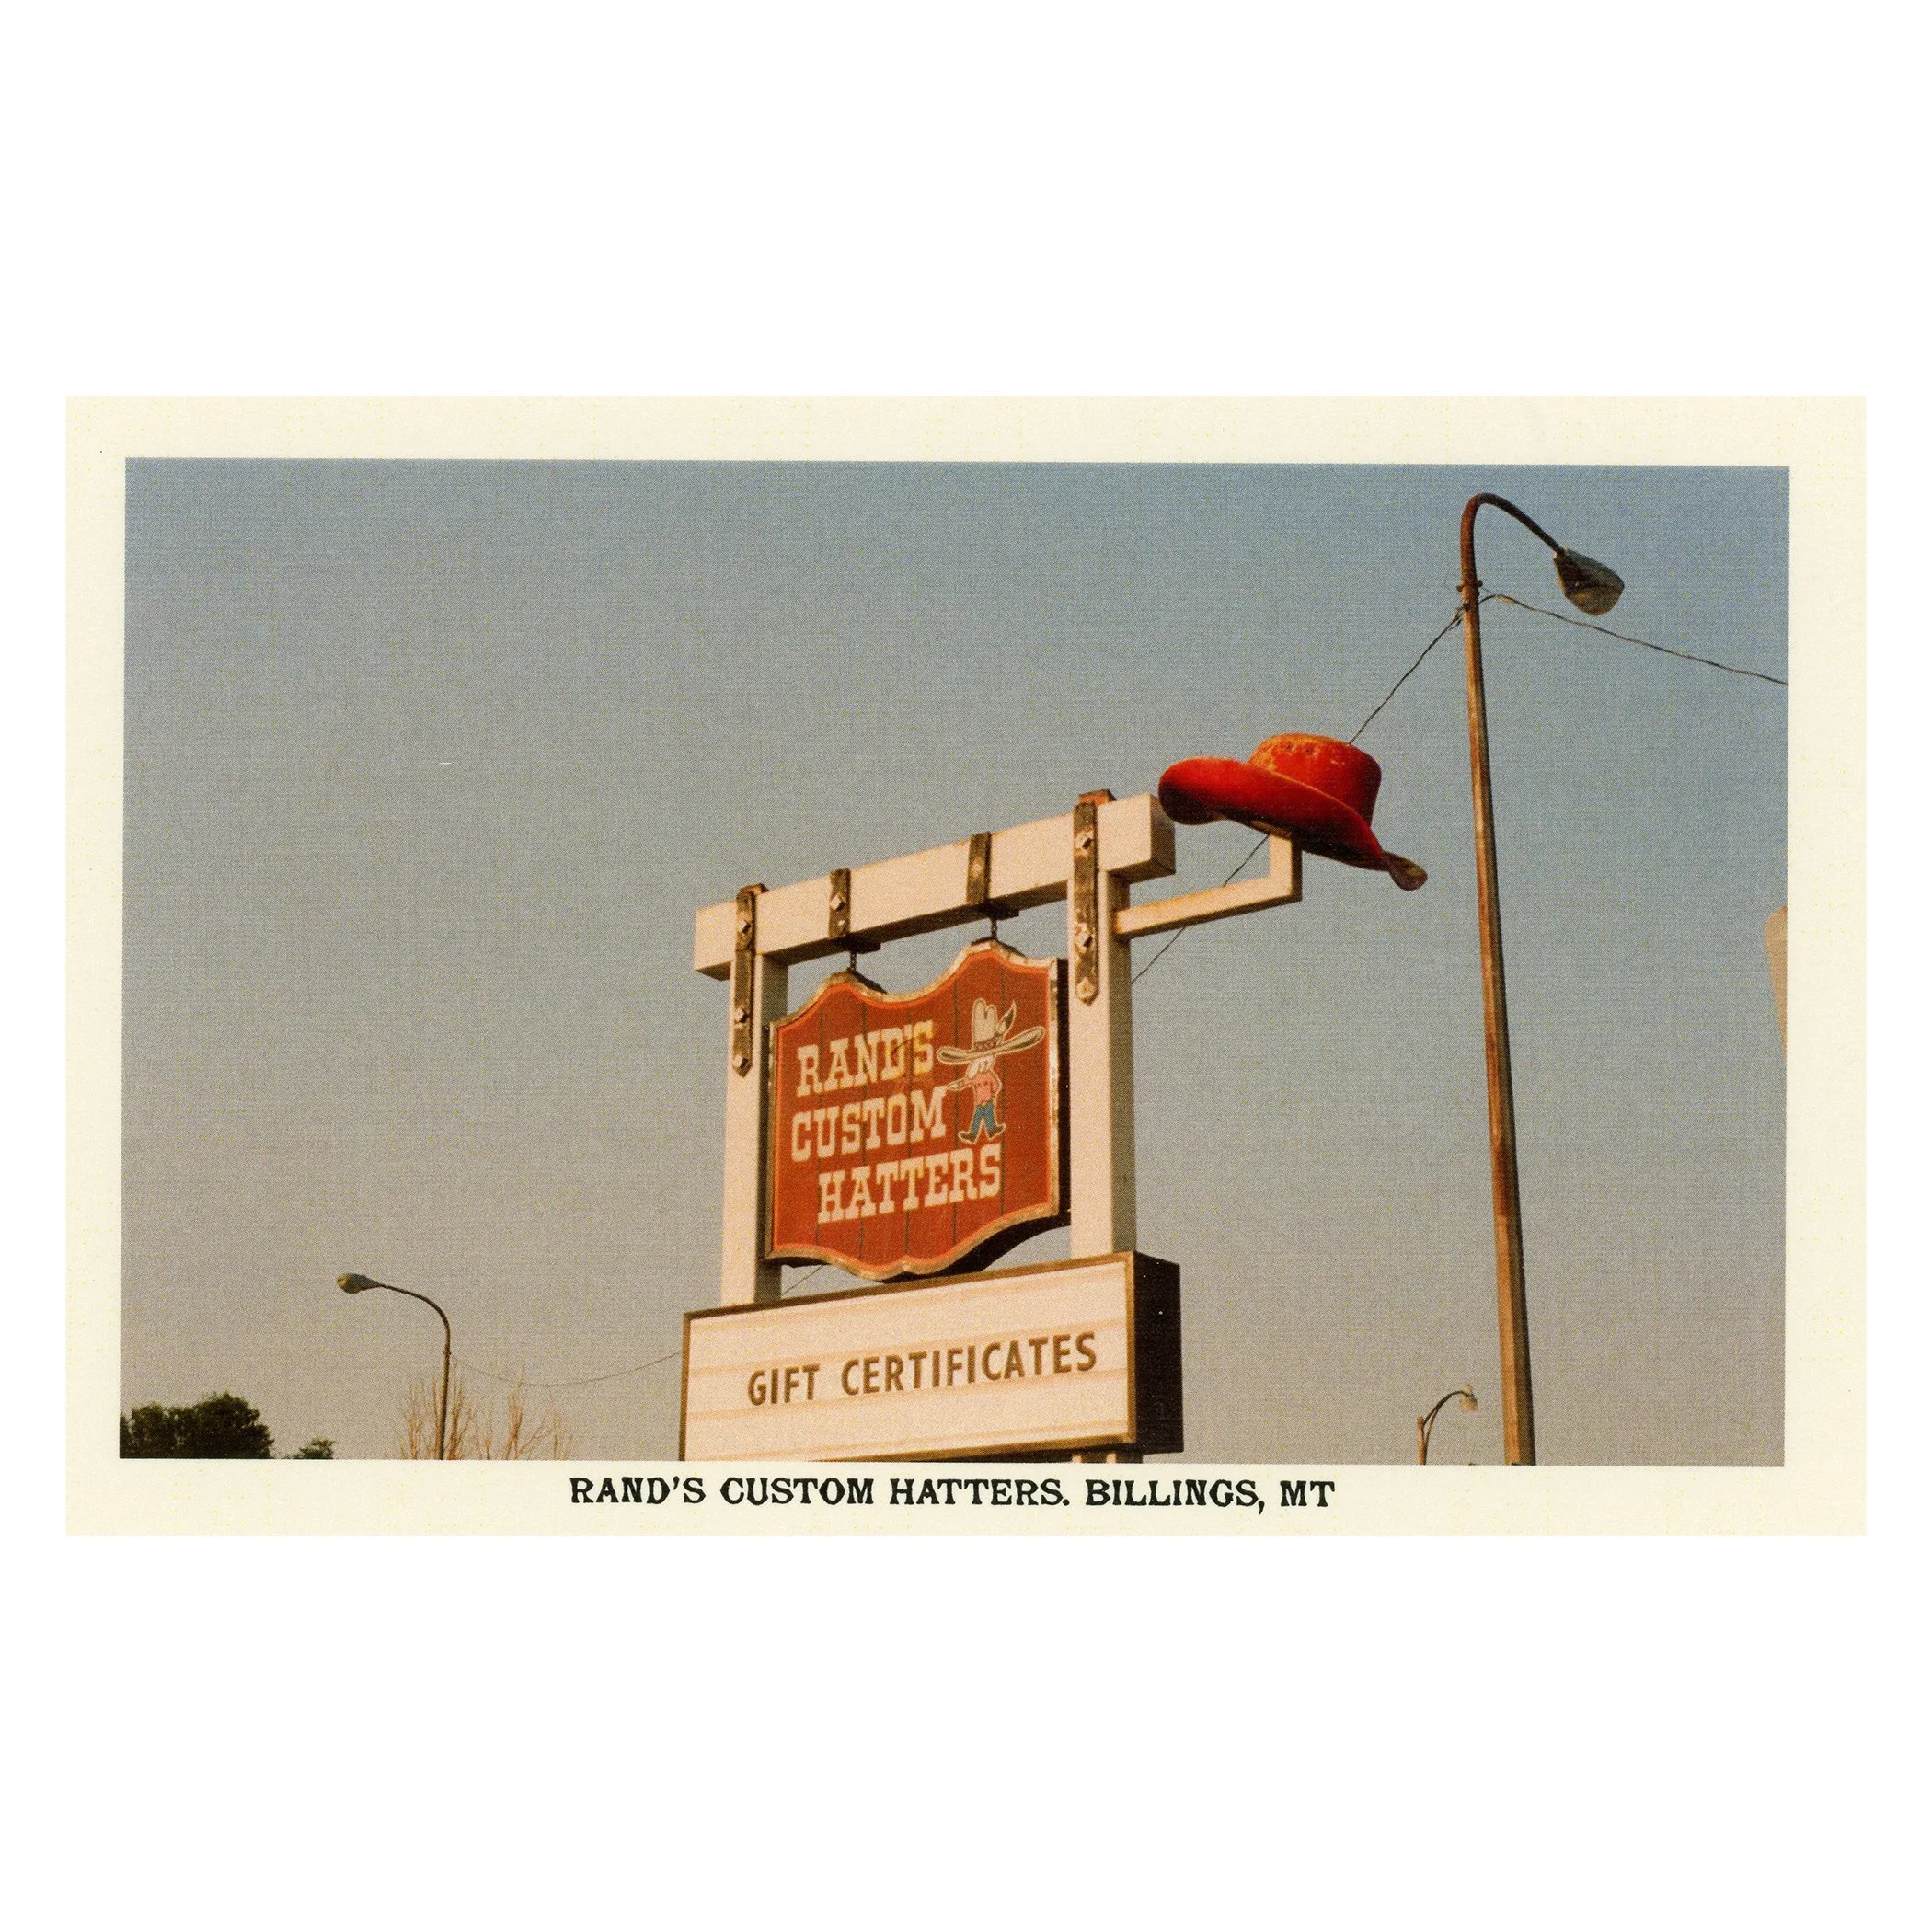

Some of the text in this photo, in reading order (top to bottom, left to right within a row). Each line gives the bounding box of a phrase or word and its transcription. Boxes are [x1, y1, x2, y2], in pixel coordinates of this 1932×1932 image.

[797, 1019, 935, 1097] RAND'S
[791, 1086, 947, 1162] CUSTOM
[817, 1144, 1002, 1224] HATTERS
[747, 1331, 1097, 1406] GIFT CERTIFICATES
